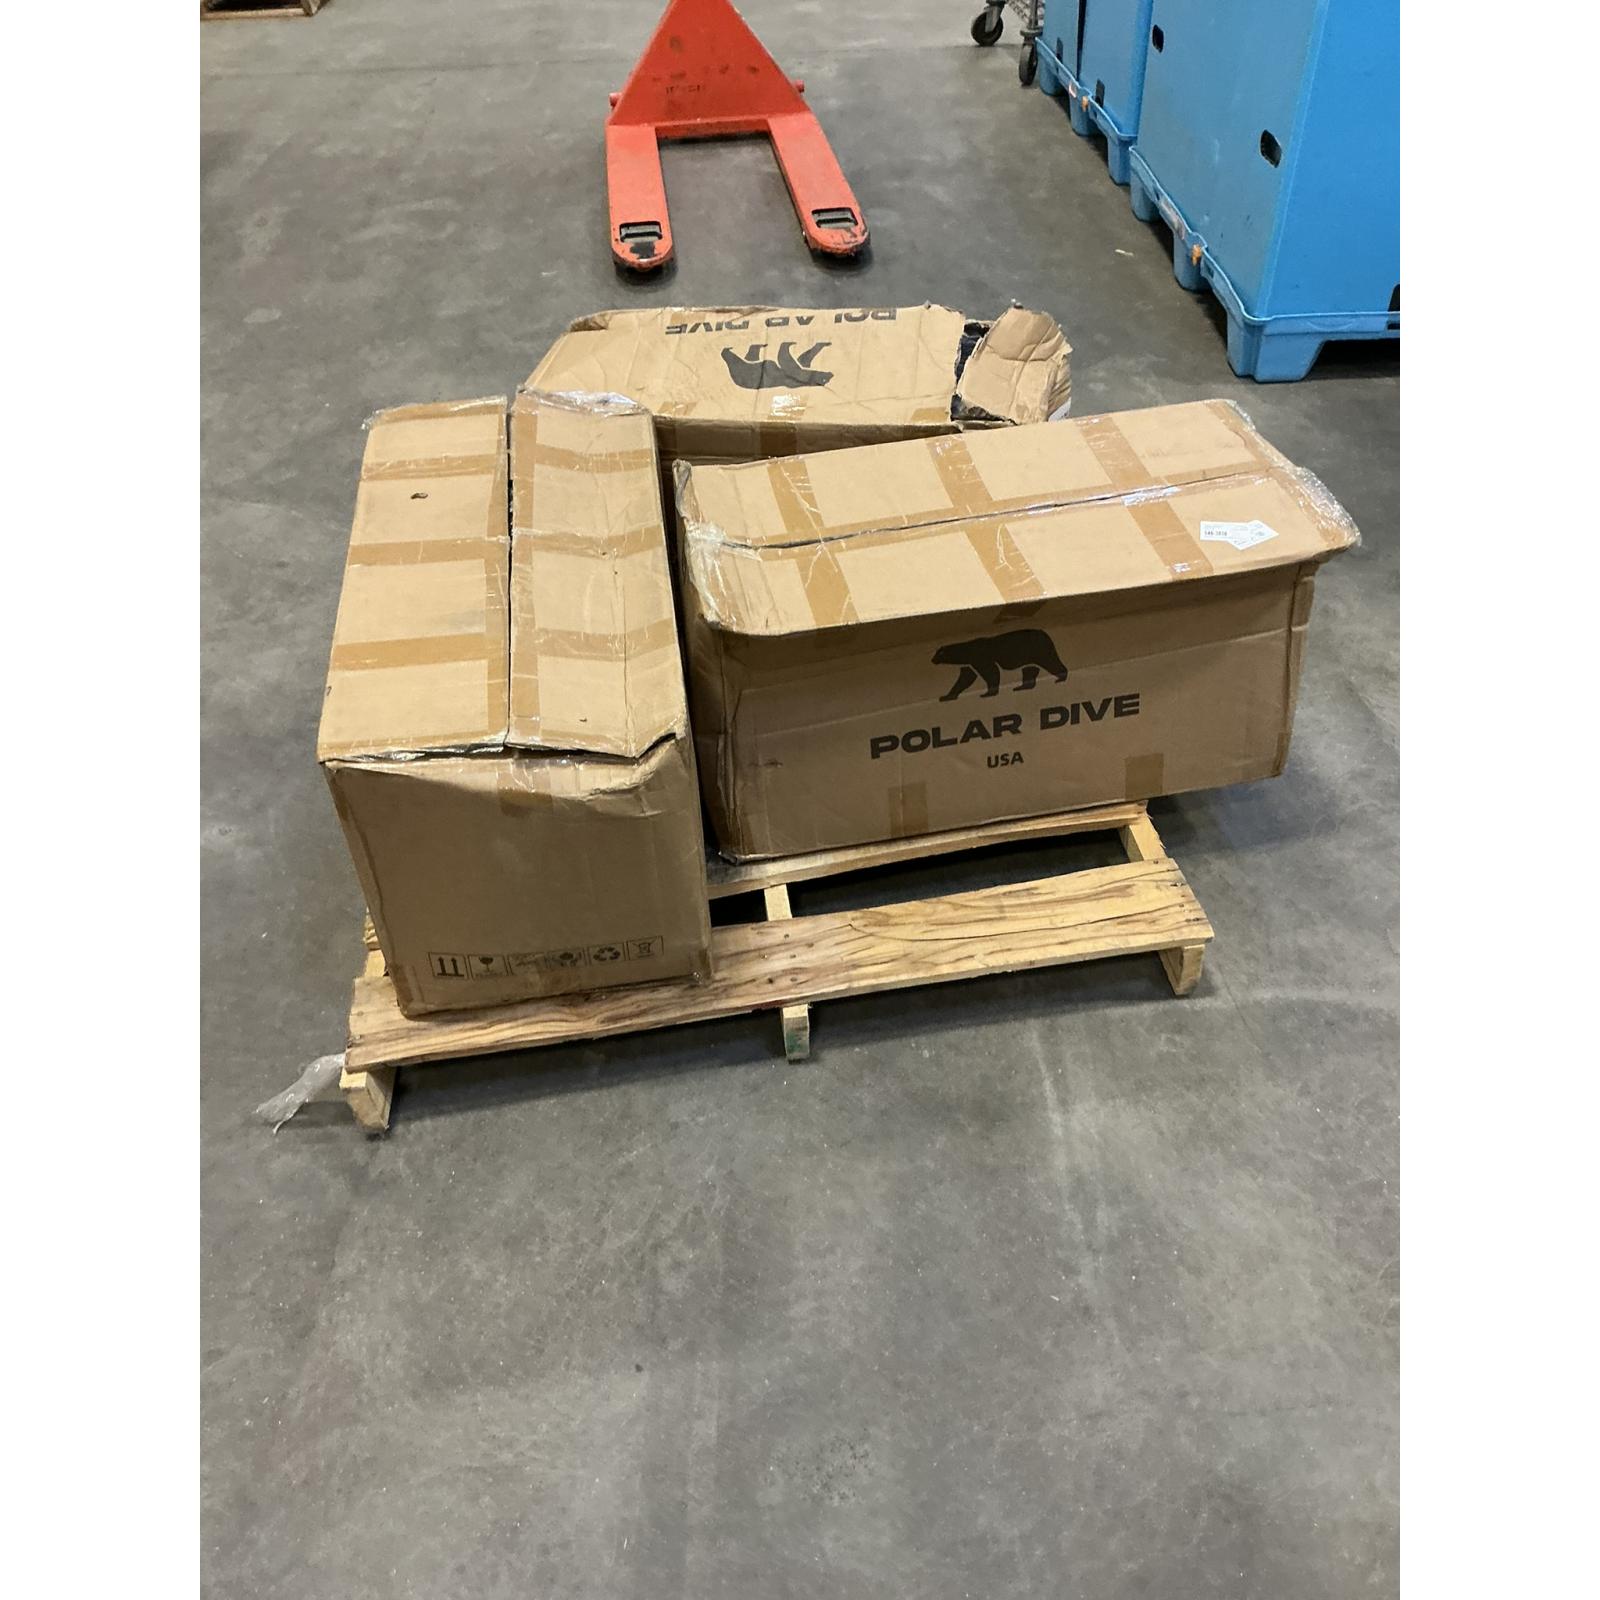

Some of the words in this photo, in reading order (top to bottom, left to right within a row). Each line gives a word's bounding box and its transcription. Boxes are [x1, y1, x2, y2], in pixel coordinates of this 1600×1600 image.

[870, 713, 1023, 760] POLAR
[1039, 693, 1141, 730] DIVE
[987, 751, 1025, 769] USA
